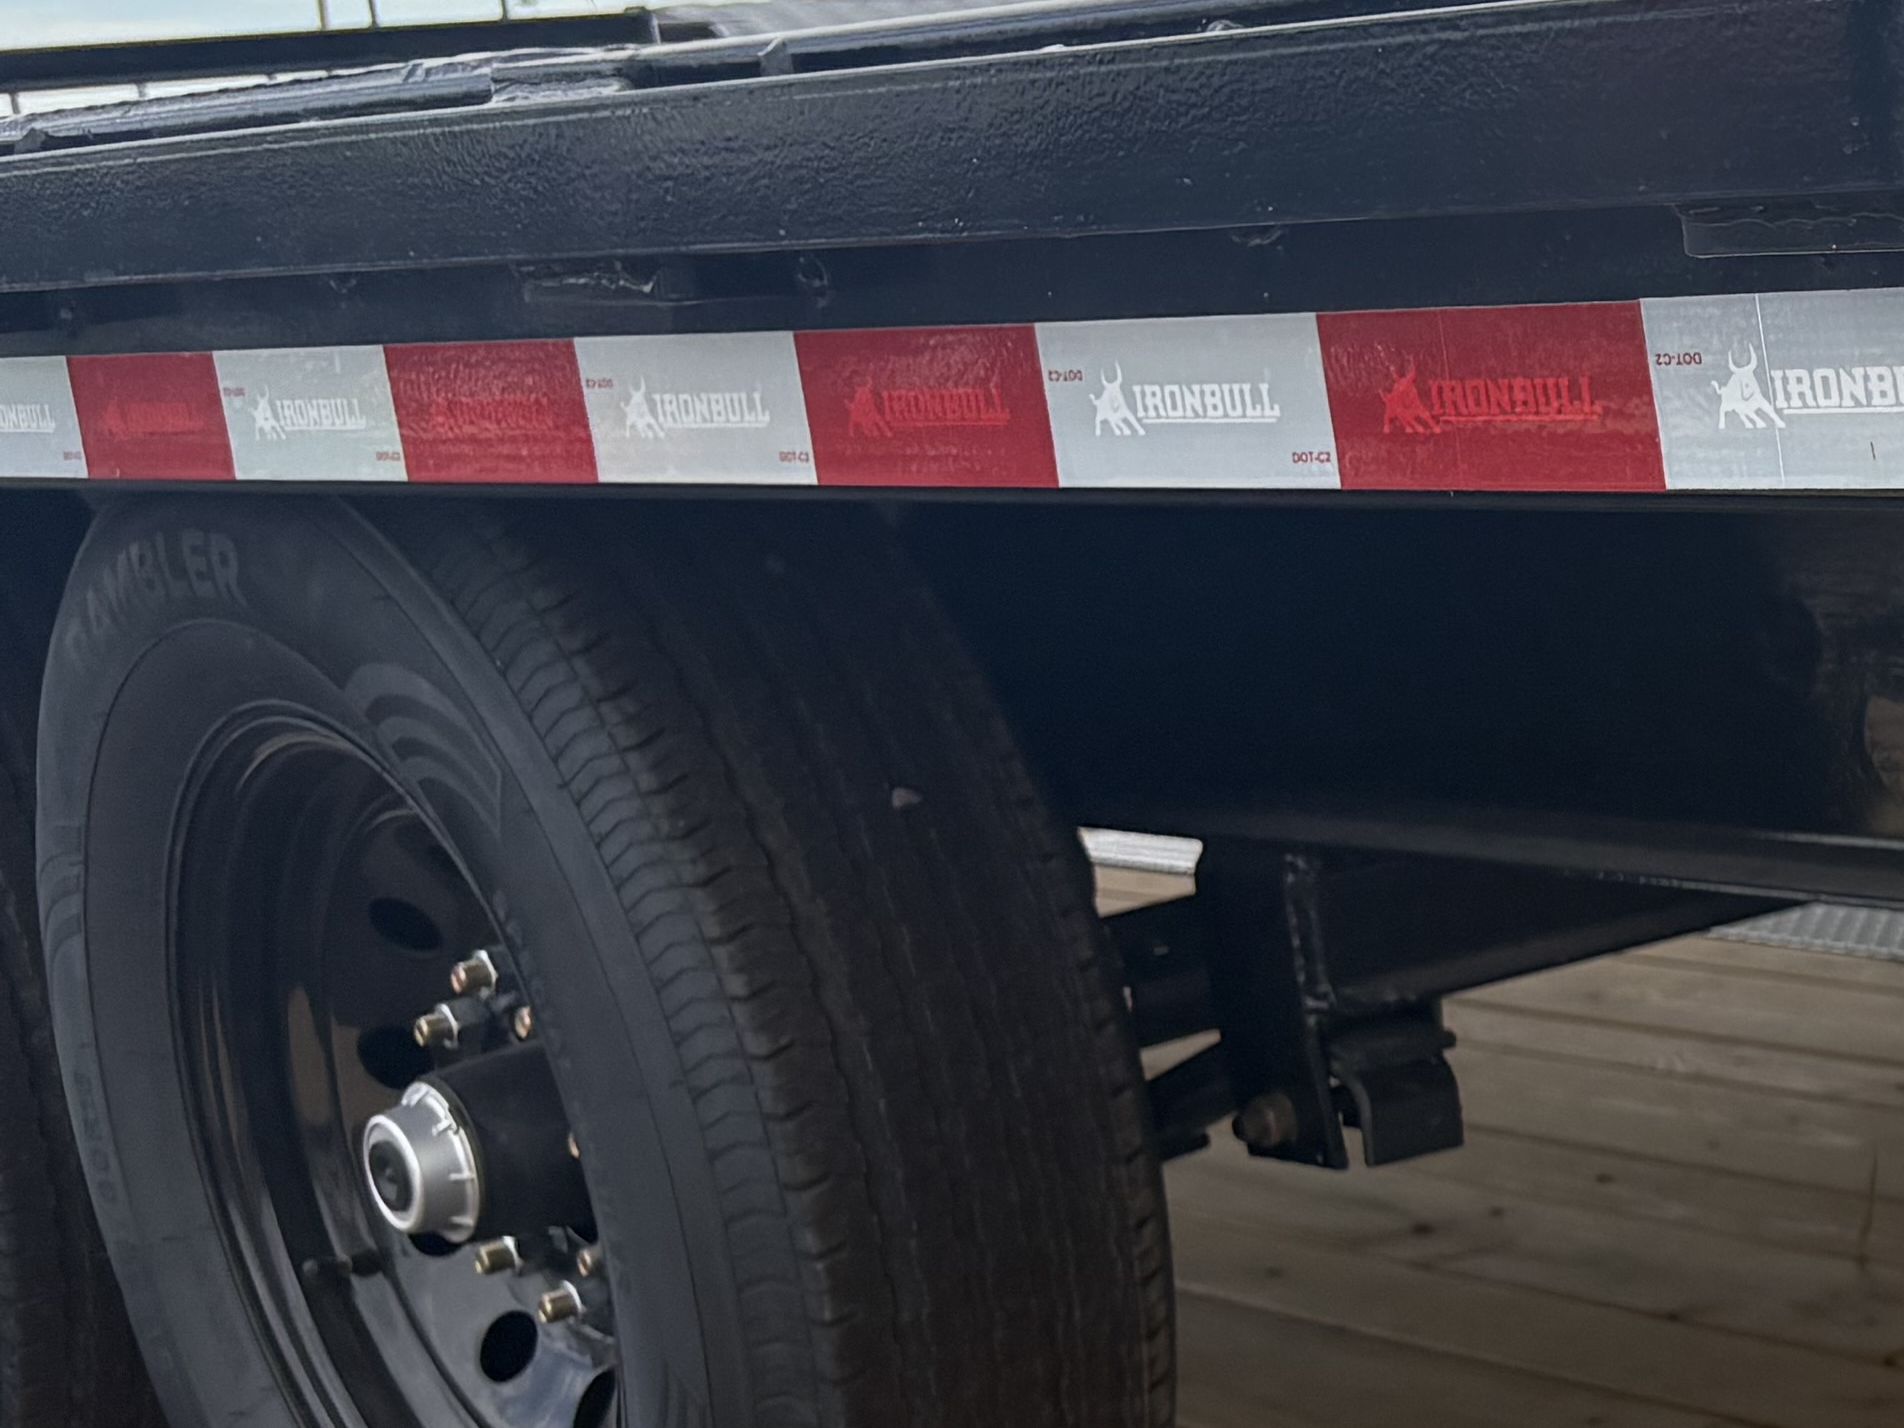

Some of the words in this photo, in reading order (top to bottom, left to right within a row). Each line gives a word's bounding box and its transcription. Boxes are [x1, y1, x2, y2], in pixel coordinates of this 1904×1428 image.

[1655, 352, 1703, 366] DOT-C2
[275, 398, 367, 425] IRONBULL
[652, 390, 771, 424] IRONBULL
[882, 387, 1012, 422] IRONBULL
[1131, 382, 1281, 419] IRONBULL
[1428, 375, 1603, 416] IRONBULL
[1291, 451, 1332, 464] DOT-C2
